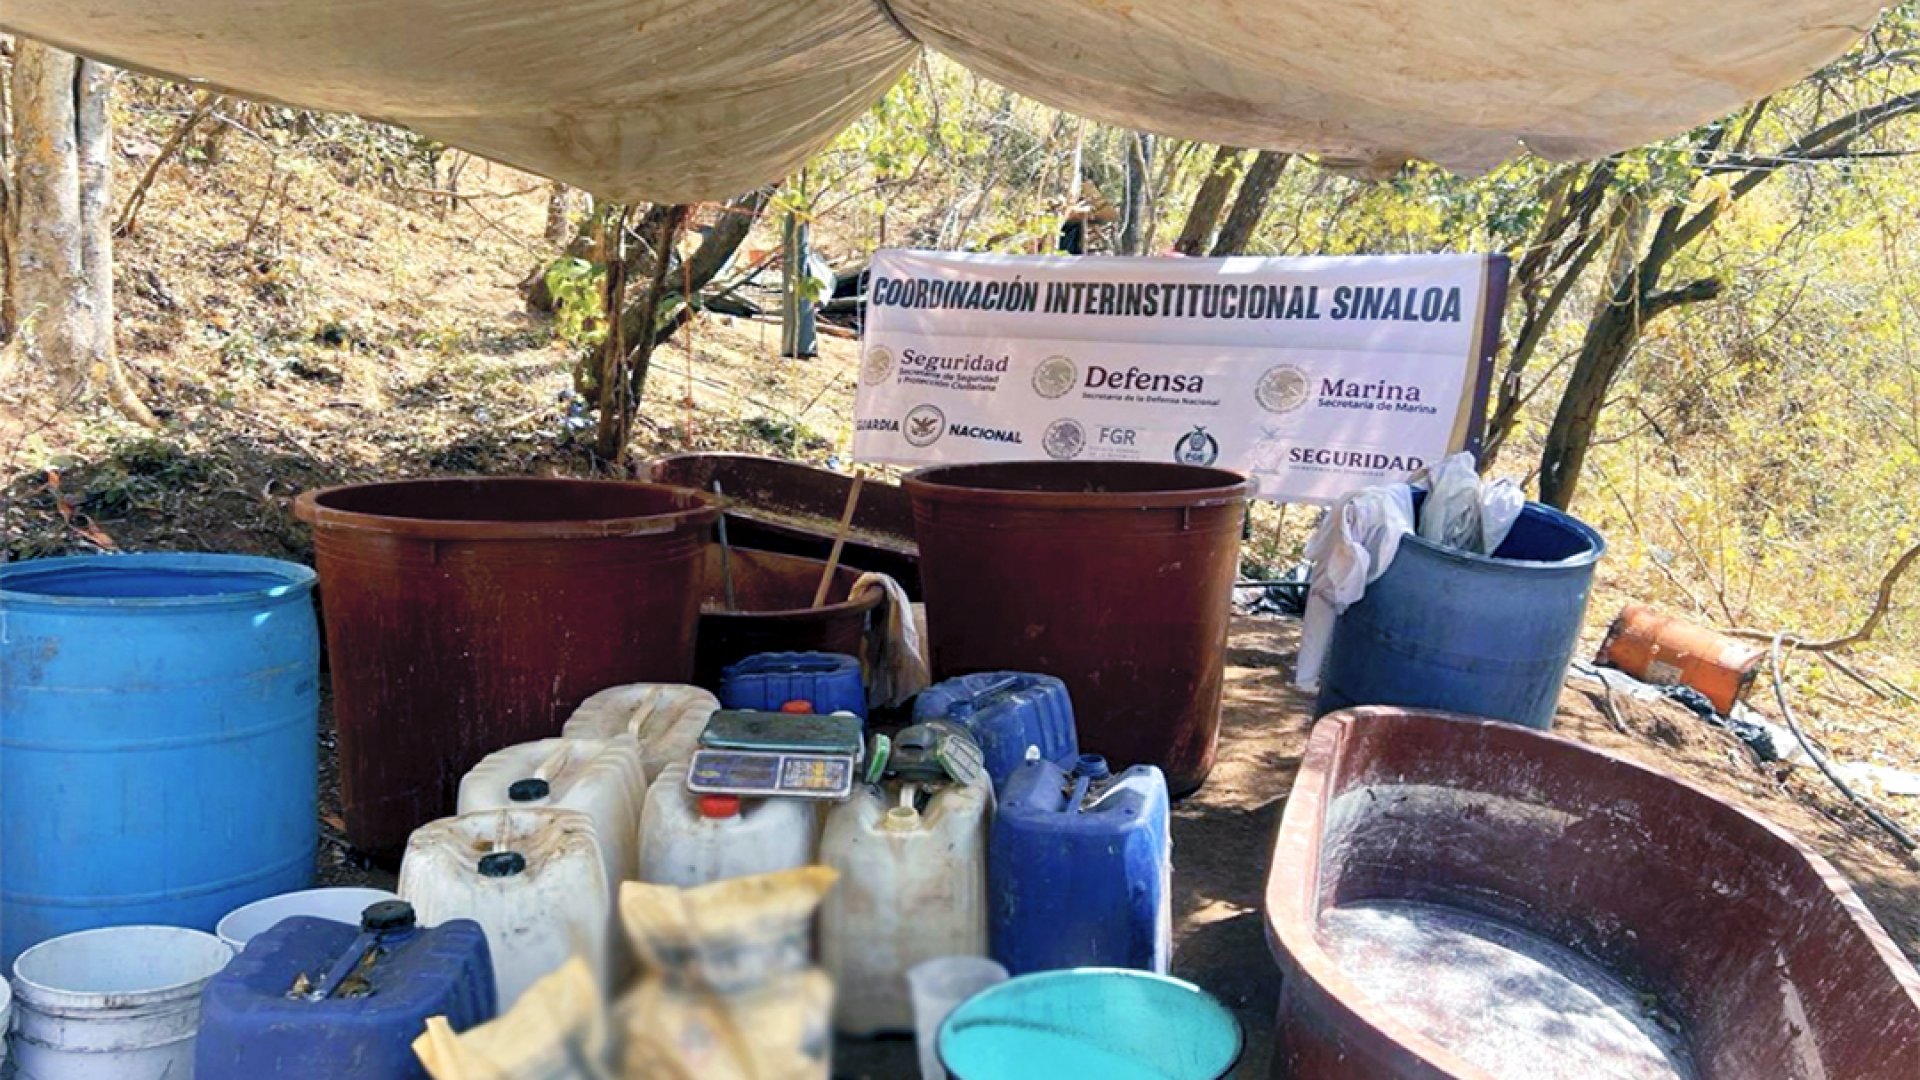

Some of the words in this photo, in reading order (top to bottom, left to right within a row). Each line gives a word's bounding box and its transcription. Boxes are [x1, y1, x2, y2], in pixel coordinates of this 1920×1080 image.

[872, 275, 1038, 311] COORDINACIÓN
[1044, 282, 1321, 319] INTERINSTITUCIONAL
[1330, 285, 1462, 322] SINALOA
[901, 348, 1009, 372] Seguridad
[1085, 365, 1204, 393] Defensa
[1320, 378, 1421, 401] Marina
[1146, 395, 1180, 404] Defensa
[1181, 397, 1219, 406] Nacional
[1376, 401, 1392, 411] de
[1395, 403, 1437, 414] Marina
[949, 423, 1023, 444] NACIONAL
[1099, 427, 1137, 446] FGR
[1289, 447, 1424, 472] SEGURIDAD
